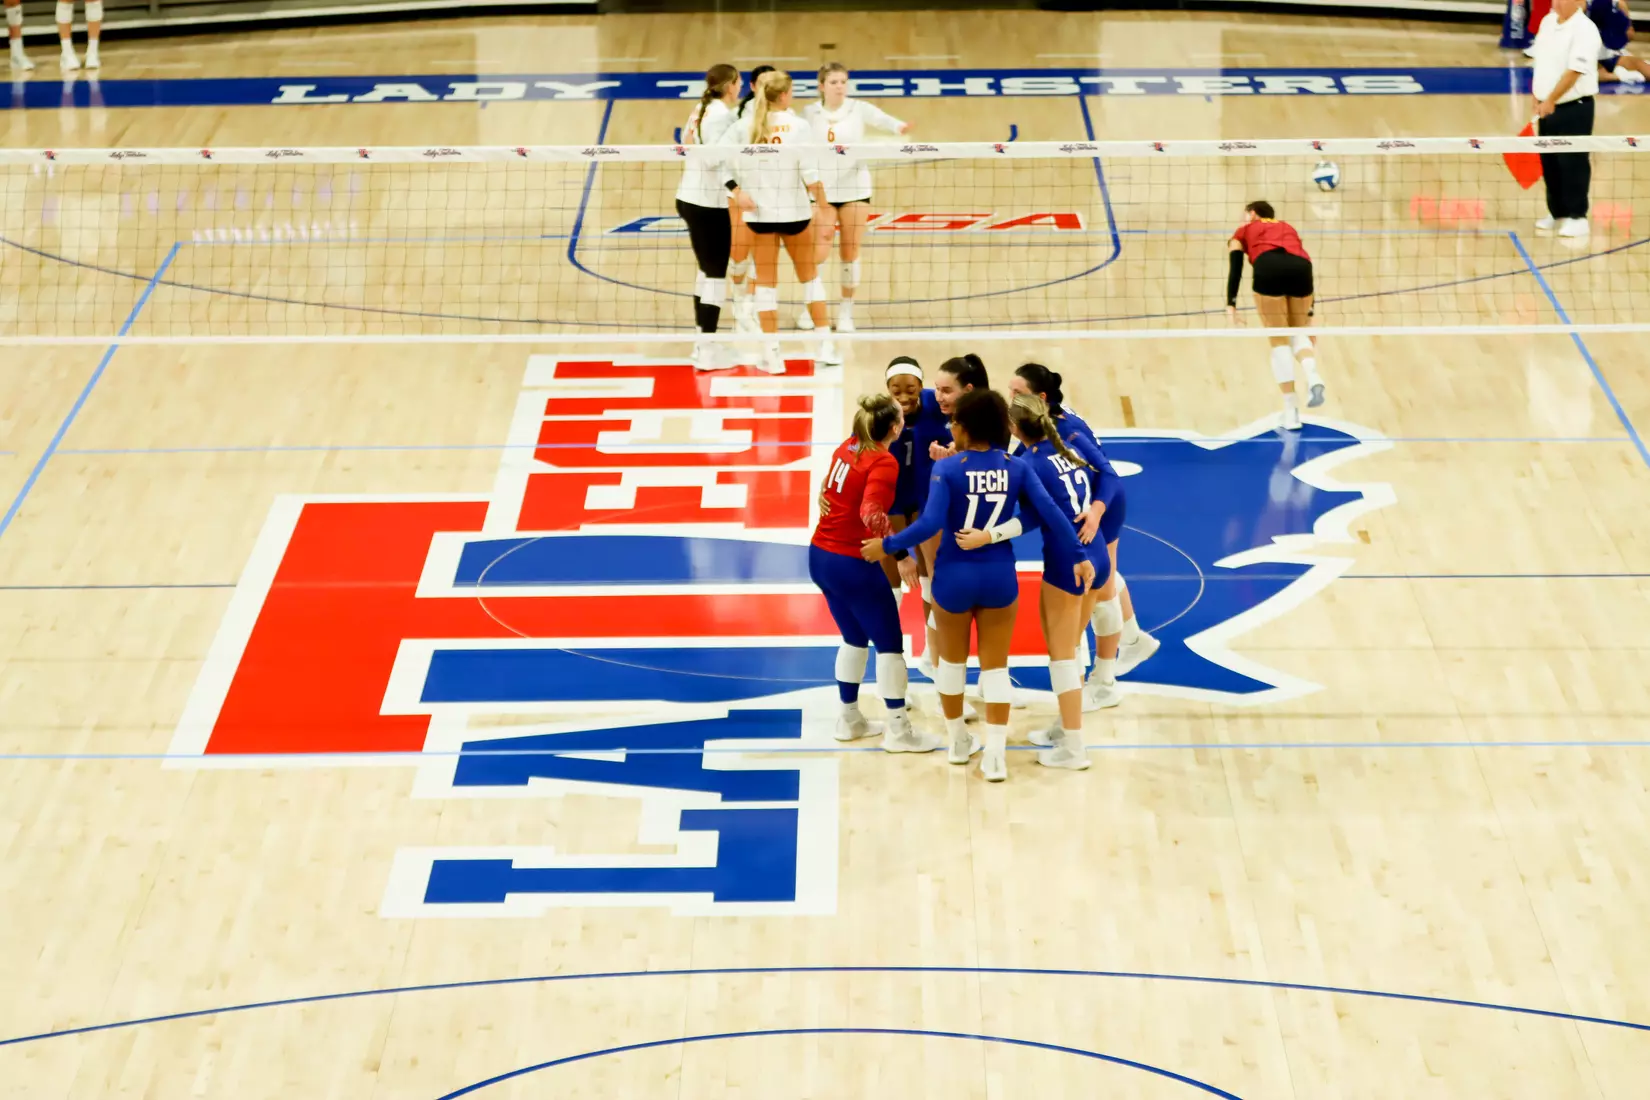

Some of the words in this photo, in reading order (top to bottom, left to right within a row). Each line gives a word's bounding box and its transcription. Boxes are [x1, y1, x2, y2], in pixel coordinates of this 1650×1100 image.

[271, 80, 622, 104] LADY
[904, 441, 913, 466] 1
[827, 458, 850, 494] 14
[965, 469, 1008, 493] TECH
[1058, 469, 1092, 515] 12
[963, 493, 1008, 531] 17
